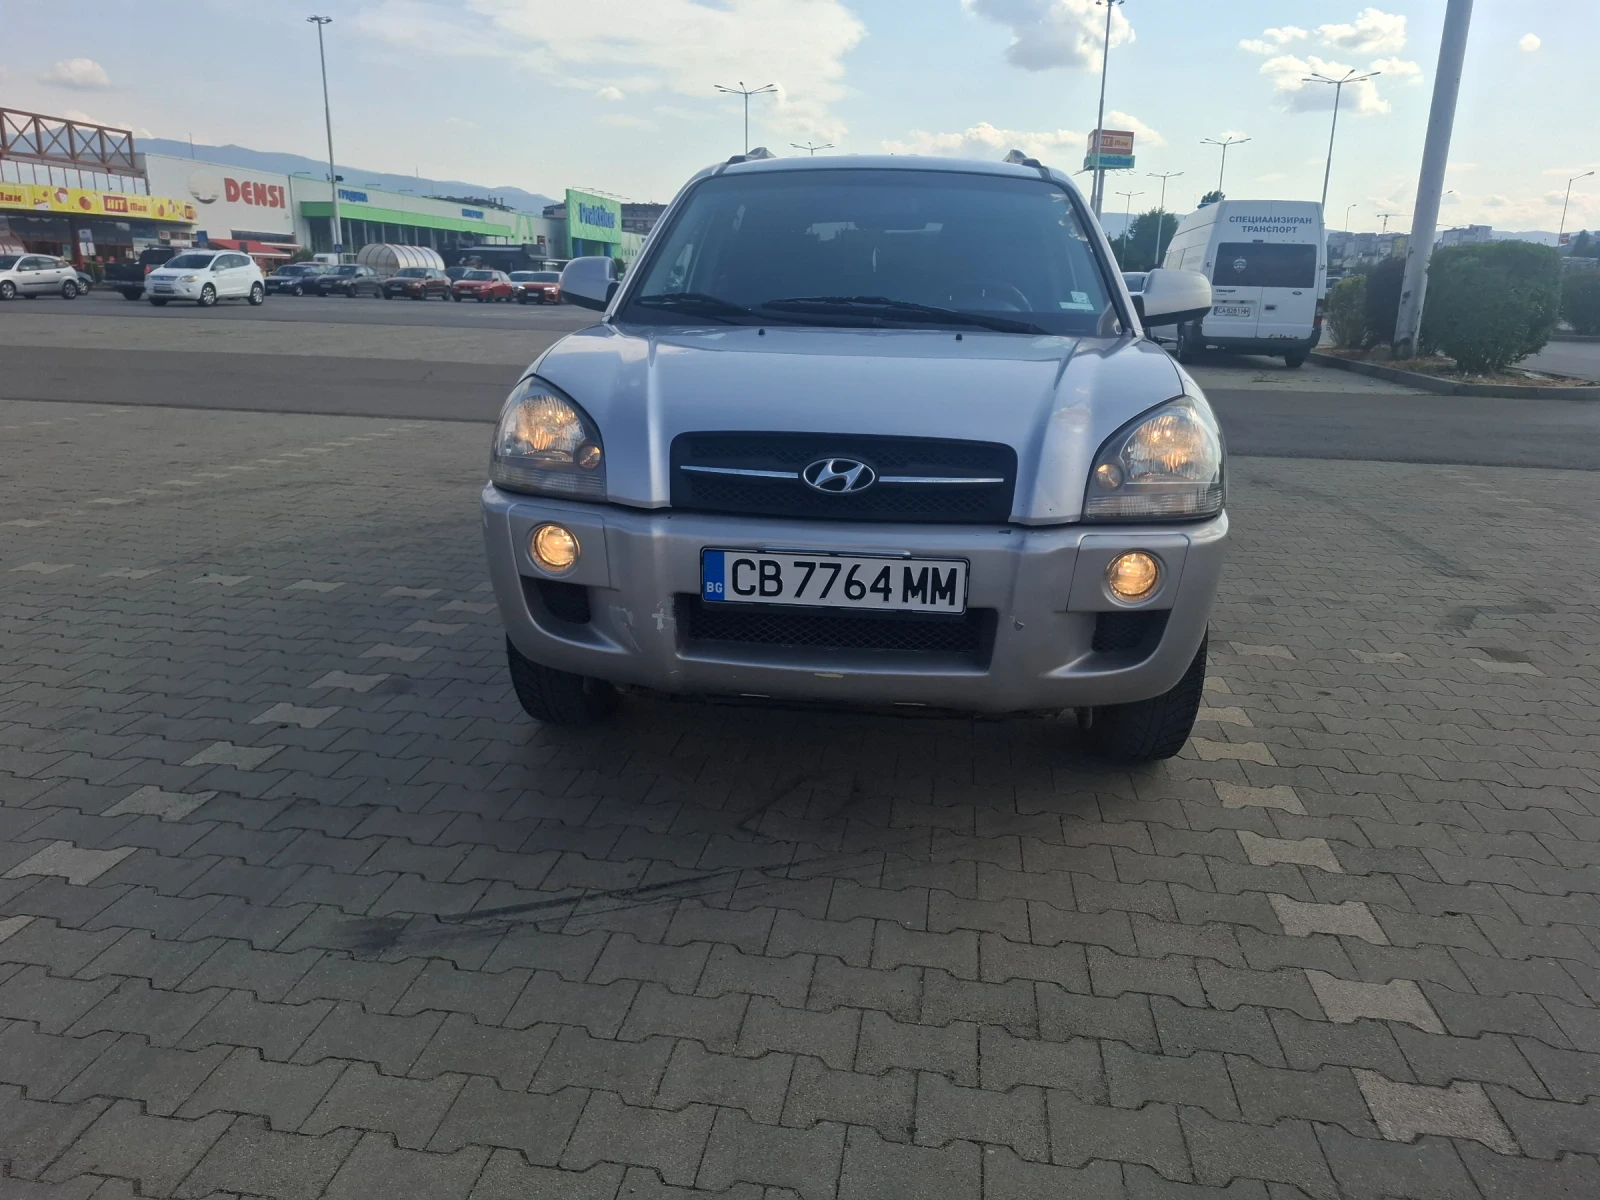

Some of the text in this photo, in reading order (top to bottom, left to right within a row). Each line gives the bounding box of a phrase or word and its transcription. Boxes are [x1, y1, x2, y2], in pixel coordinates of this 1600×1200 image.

[224, 177, 286, 209] DENSI
[107, 198, 125, 210] HIT
[1228, 215, 1312, 225] СПЕЦИАЛИЗИРАН
[1241, 225, 1298, 234] ТРАНСПОРТ
[706, 581, 723, 593] BG
[731, 558, 958, 606] CB 7764 MM
